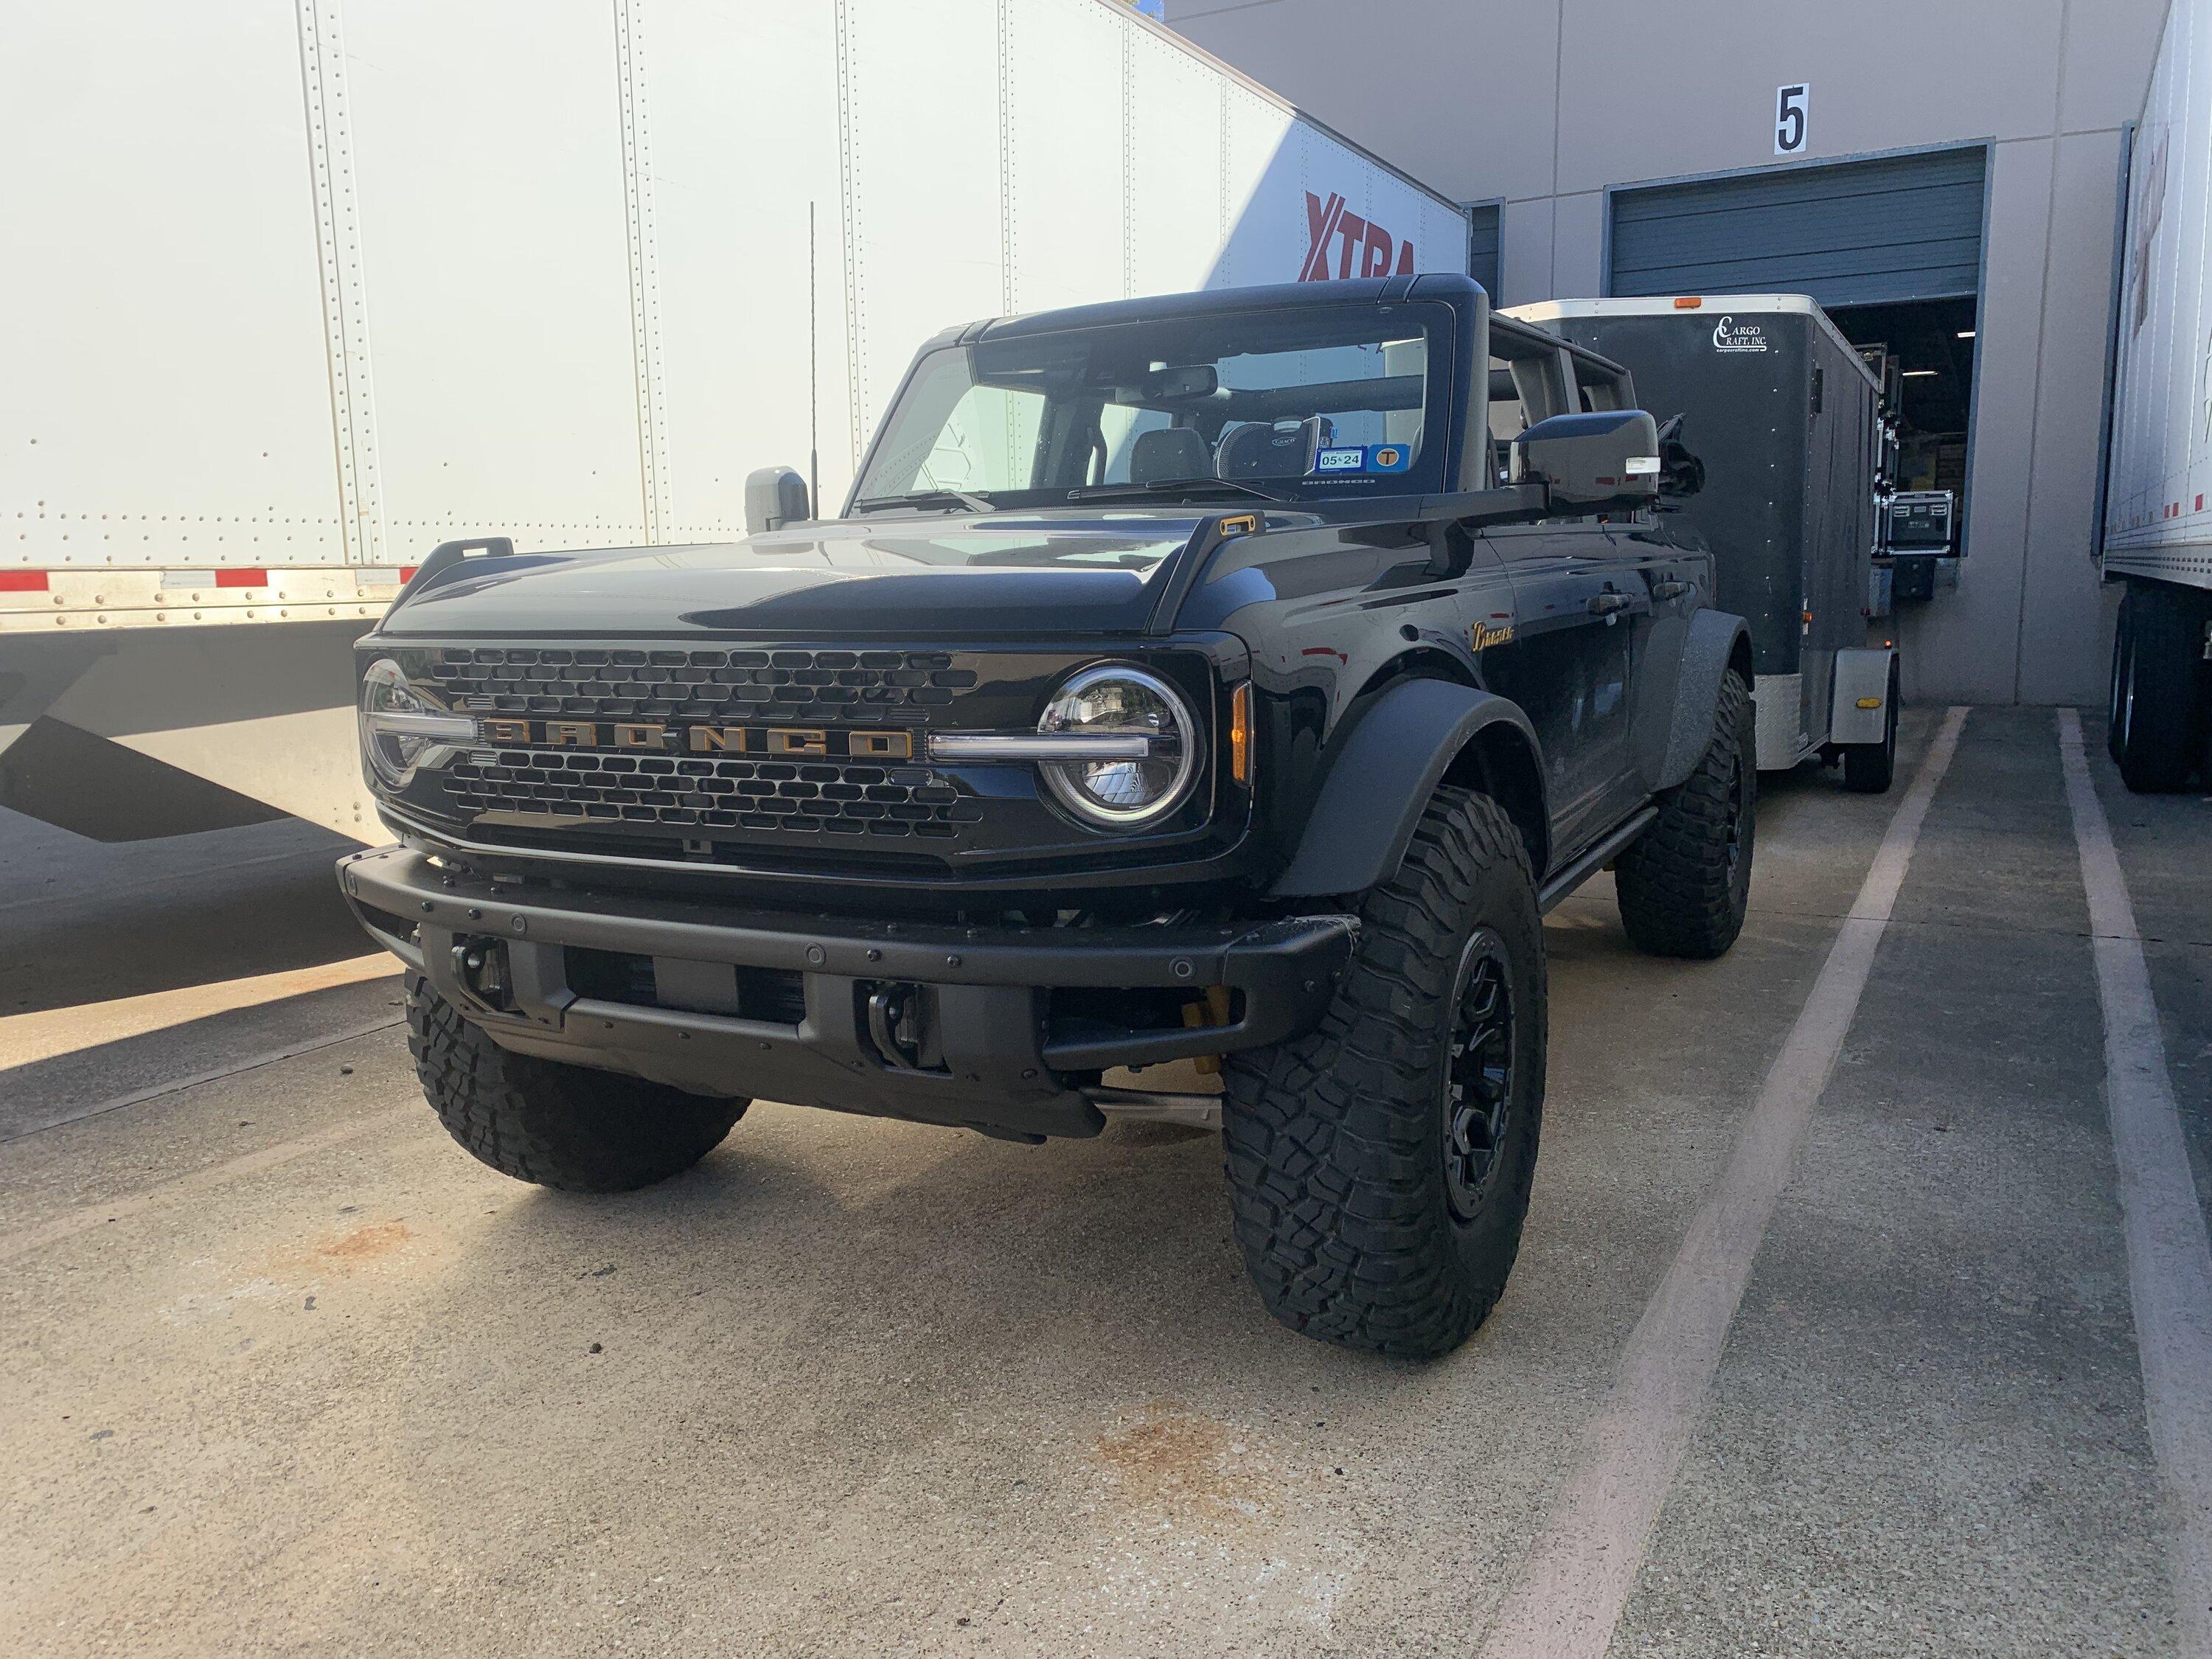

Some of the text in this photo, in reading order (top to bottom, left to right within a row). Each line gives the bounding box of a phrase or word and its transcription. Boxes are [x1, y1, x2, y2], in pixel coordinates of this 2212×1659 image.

[1778, 86, 1804, 150] 5
[1718, 316, 1760, 338] CARGO
[1751, 336, 1767, 345] INC.
[1381, 451, 1396, 465] T
[483, 717, 914, 759] BRONCO
